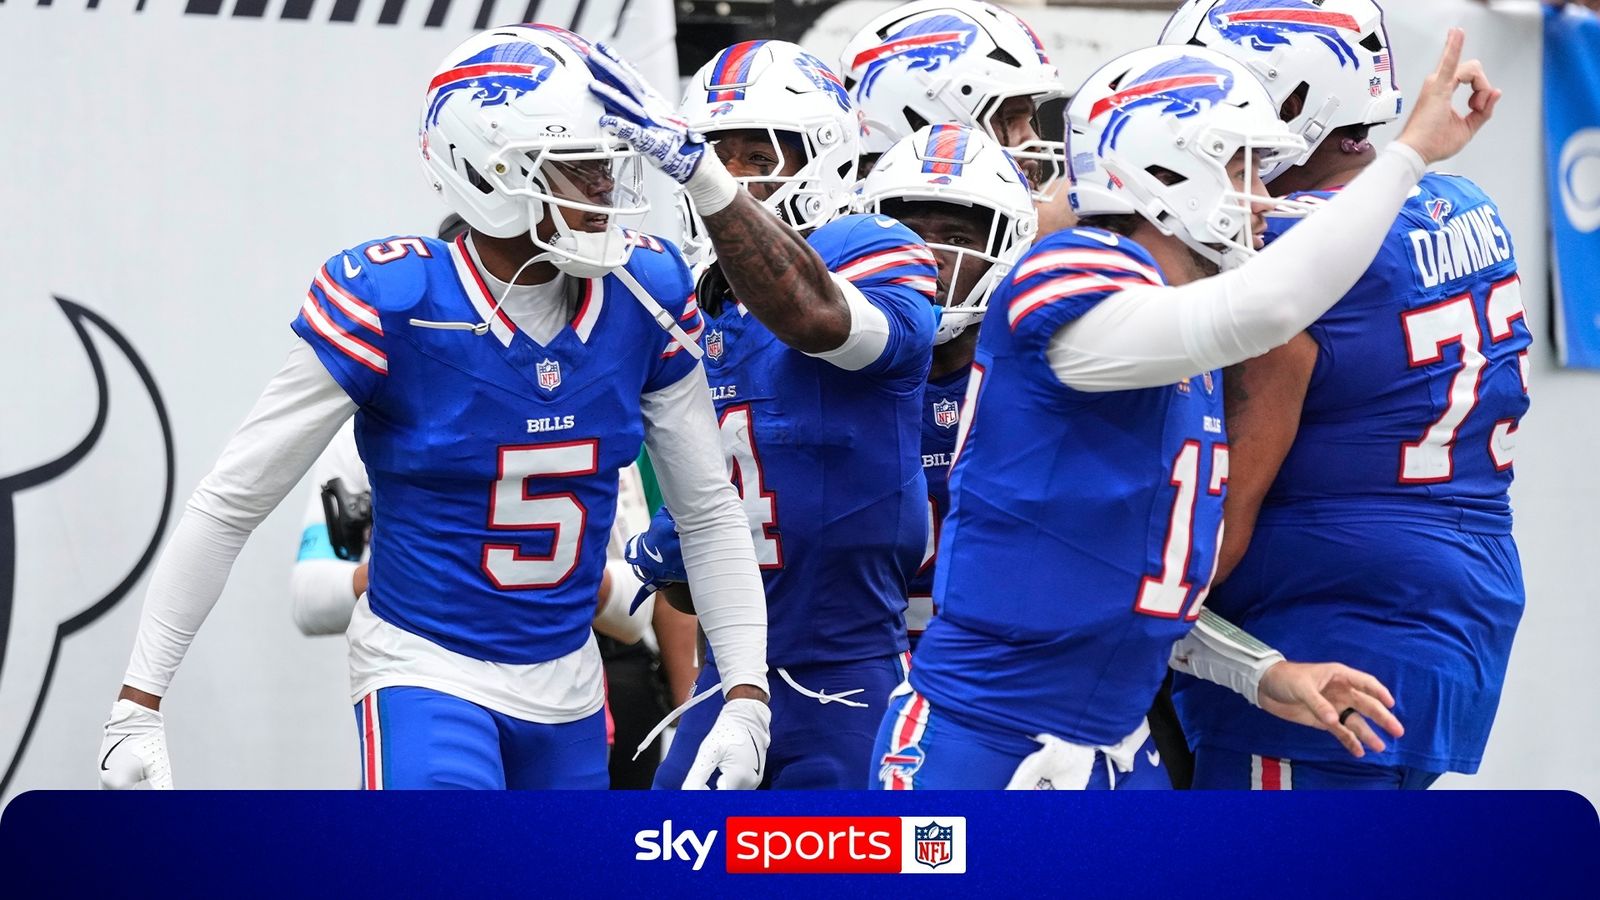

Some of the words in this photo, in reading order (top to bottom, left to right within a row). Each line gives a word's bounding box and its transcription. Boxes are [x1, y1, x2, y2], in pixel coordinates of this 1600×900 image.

[364, 237, 433, 265] 5
[1409, 204, 1510, 288] DAWKINS
[526, 415, 575, 433] BILLS
[709, 385, 737, 400] ILLS
[1399, 272, 1530, 484] 73
[482, 438, 599, 591] 5
[719, 402, 785, 570] 4
[1134, 438, 1229, 622] 17
